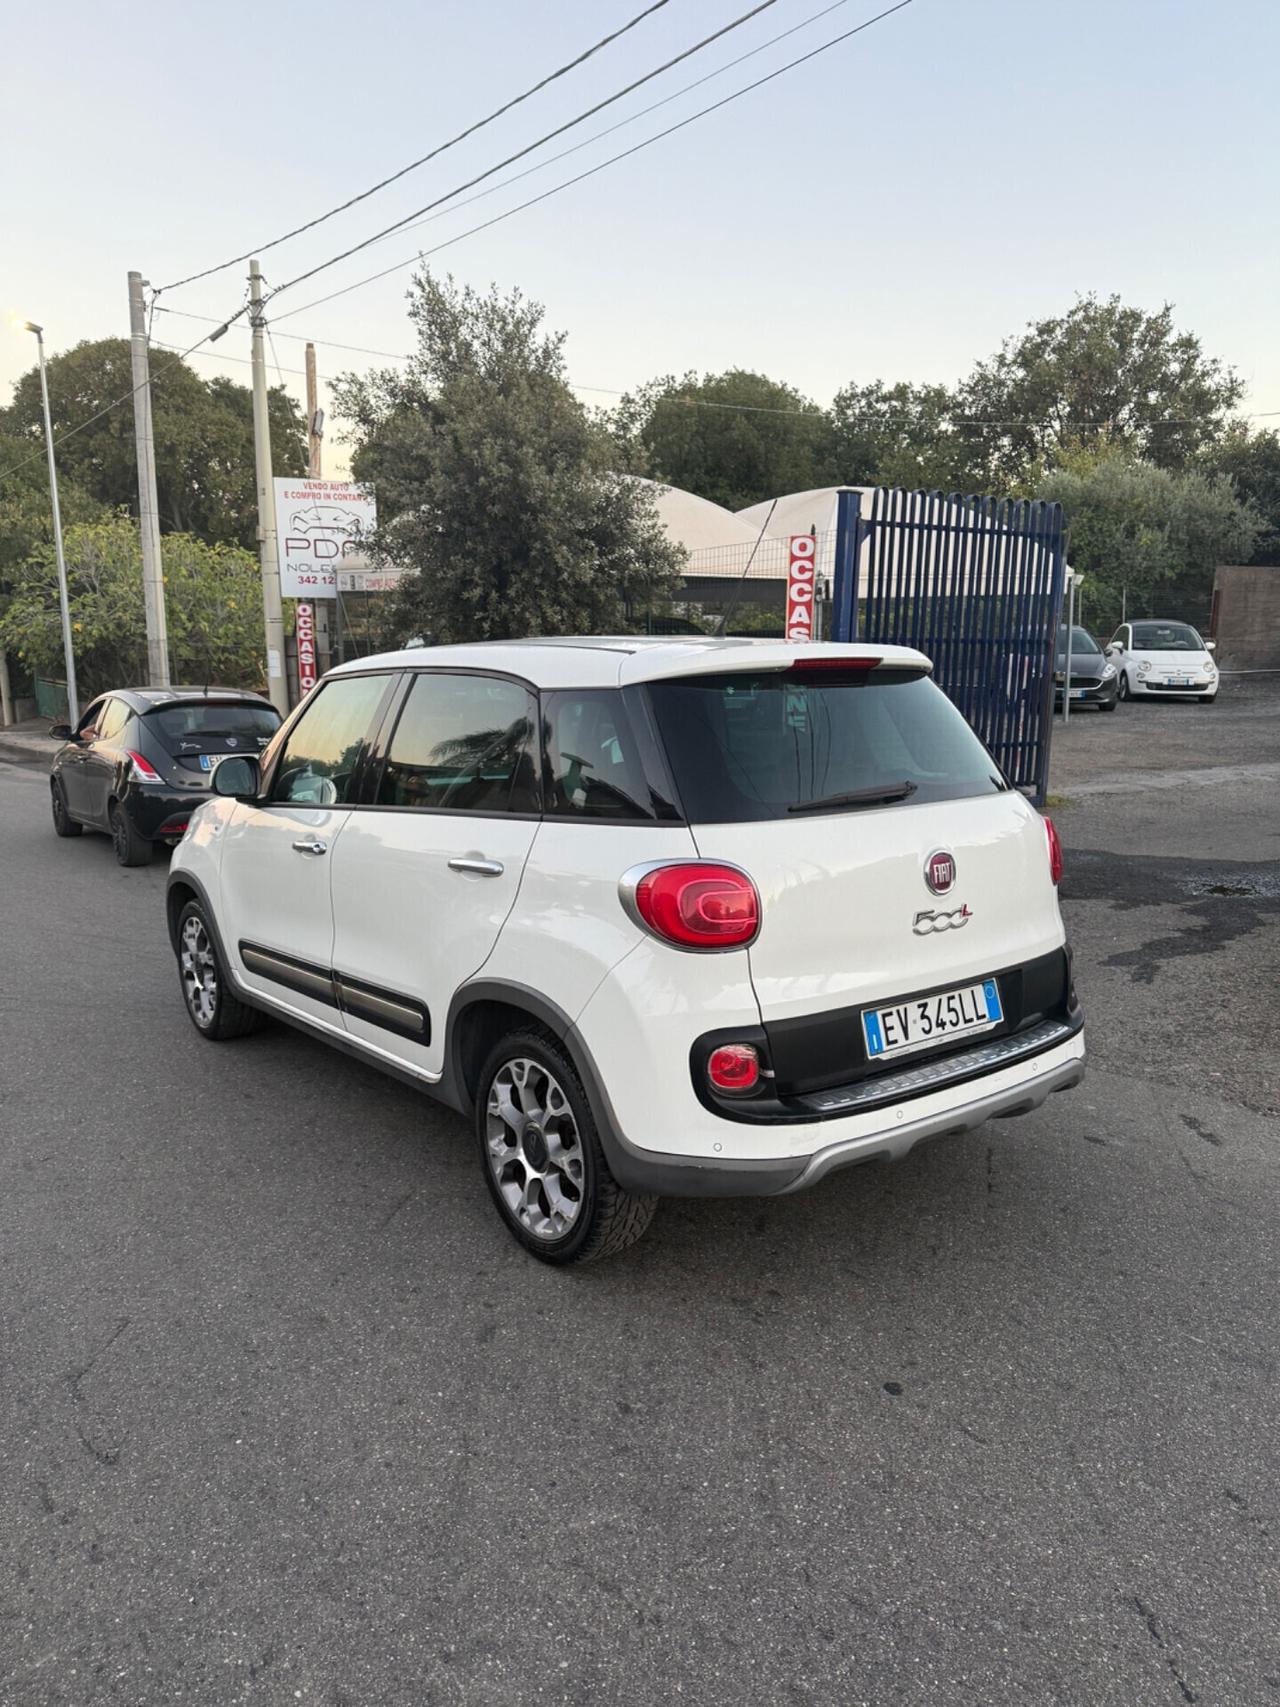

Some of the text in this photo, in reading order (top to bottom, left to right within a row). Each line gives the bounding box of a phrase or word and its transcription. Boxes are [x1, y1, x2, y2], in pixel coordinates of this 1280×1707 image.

[330, 483, 349, 491] AUTO
[284, 491, 289, 499] E
[291, 492, 321, 500] COMPRO
[298, 576, 318, 584] 342
[934, 862, 951, 884] FIAT
[881, 1007, 909, 1046] EV
[917, 990, 986, 1035] 345LL
